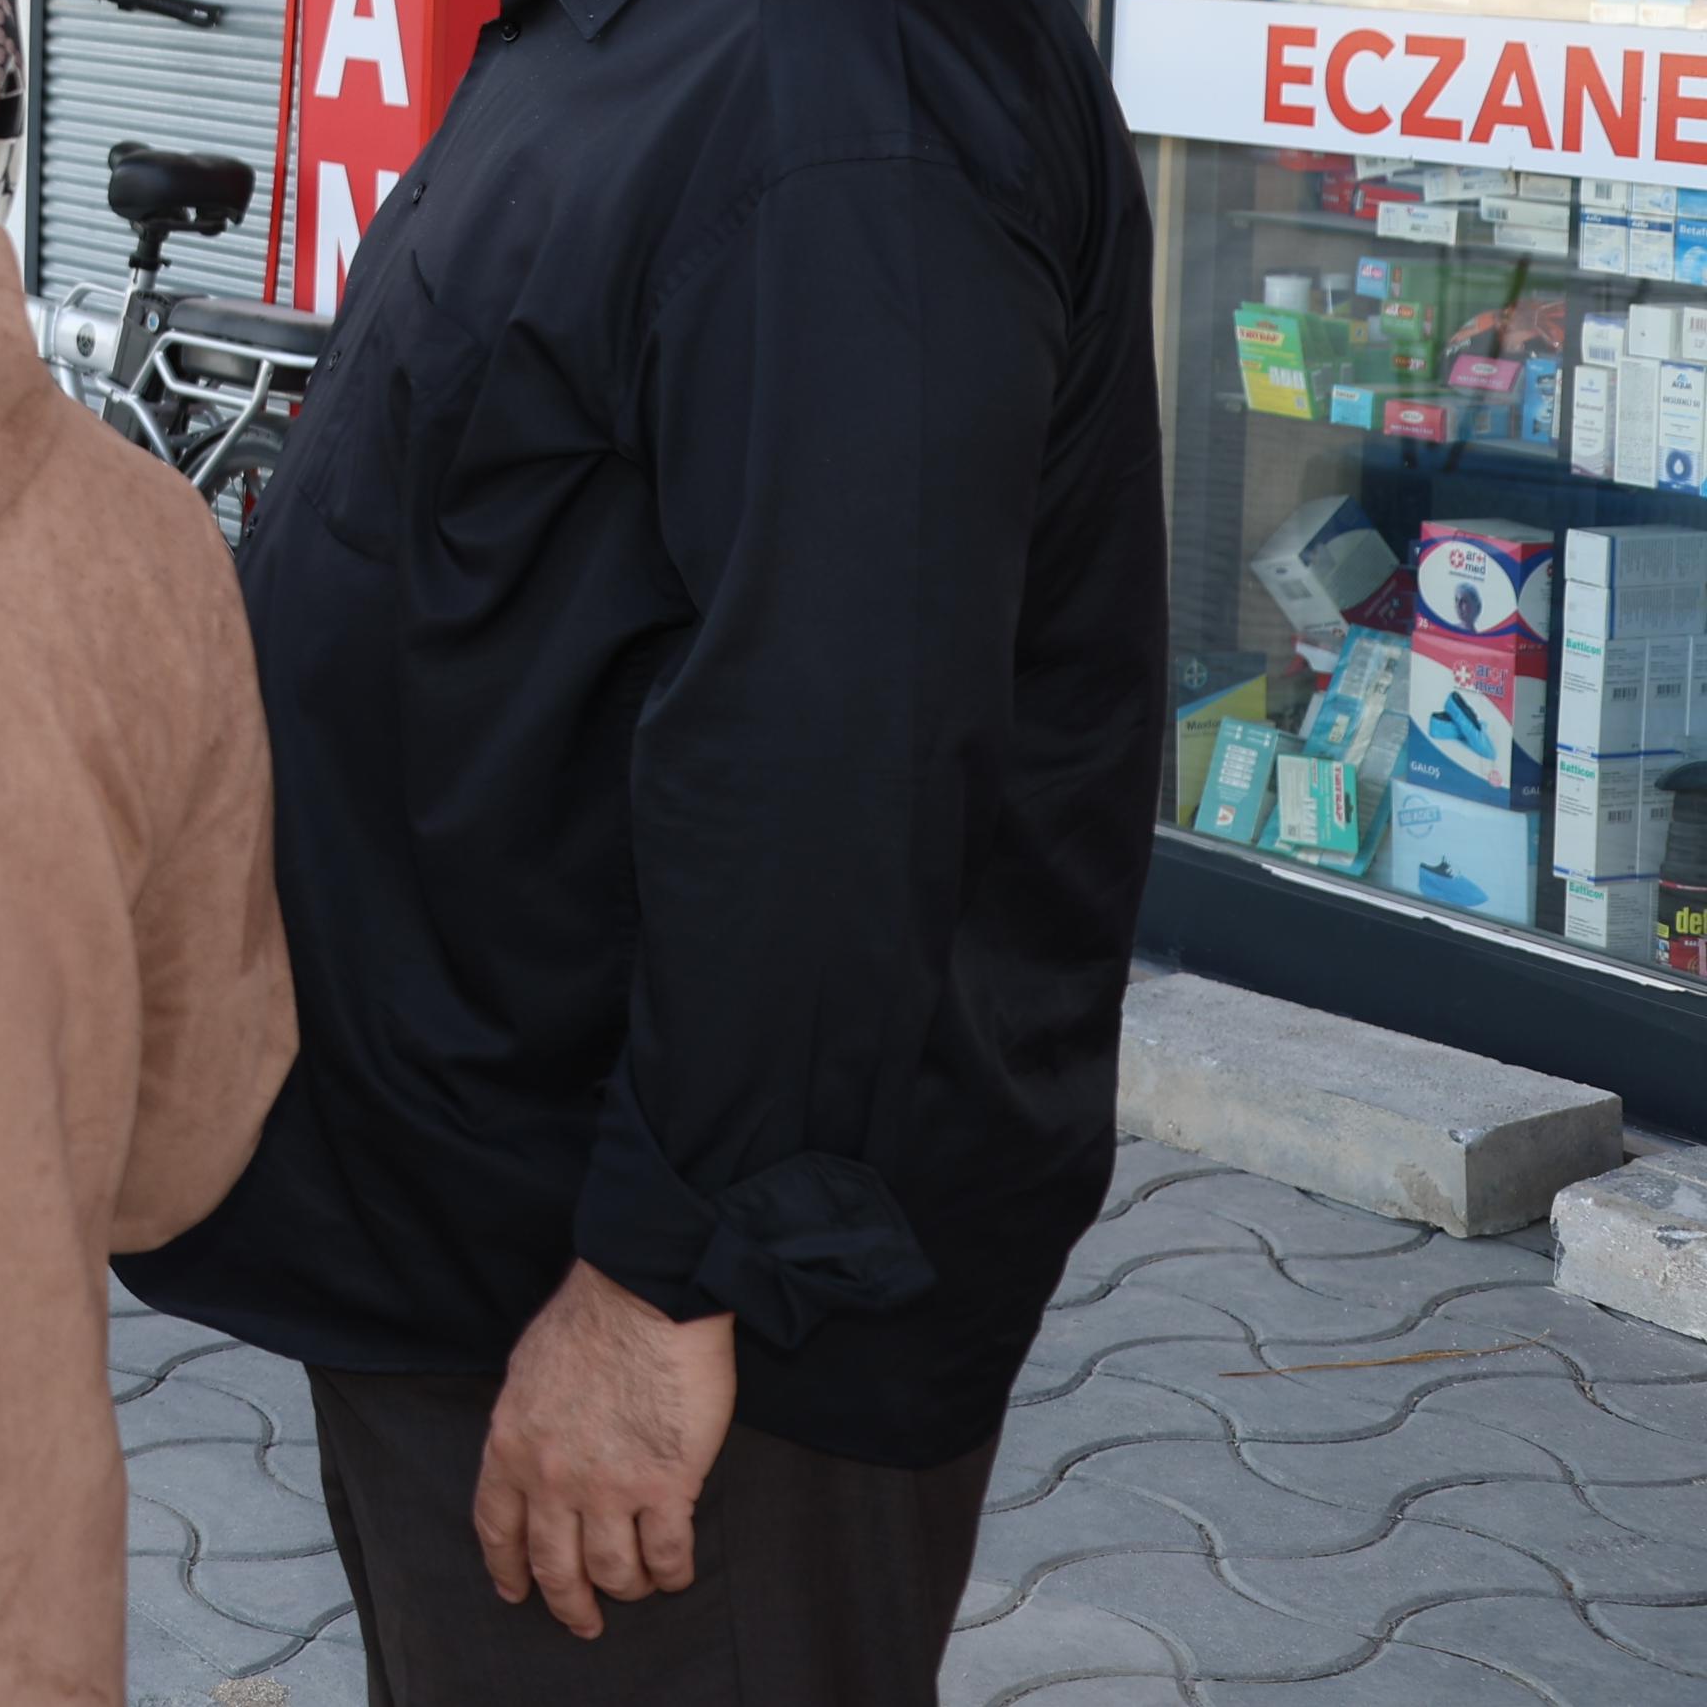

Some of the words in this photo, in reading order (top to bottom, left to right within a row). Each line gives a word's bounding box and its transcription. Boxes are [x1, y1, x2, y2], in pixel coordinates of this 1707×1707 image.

[1263, 23, 1707, 165] ECZANE
[1565, 637, 1603, 656] Batticon
[1410, 760, 1441, 779] GALOŞ
[1559, 759, 1596, 779] Batticon
[1675, 906, 1707, 935] de
